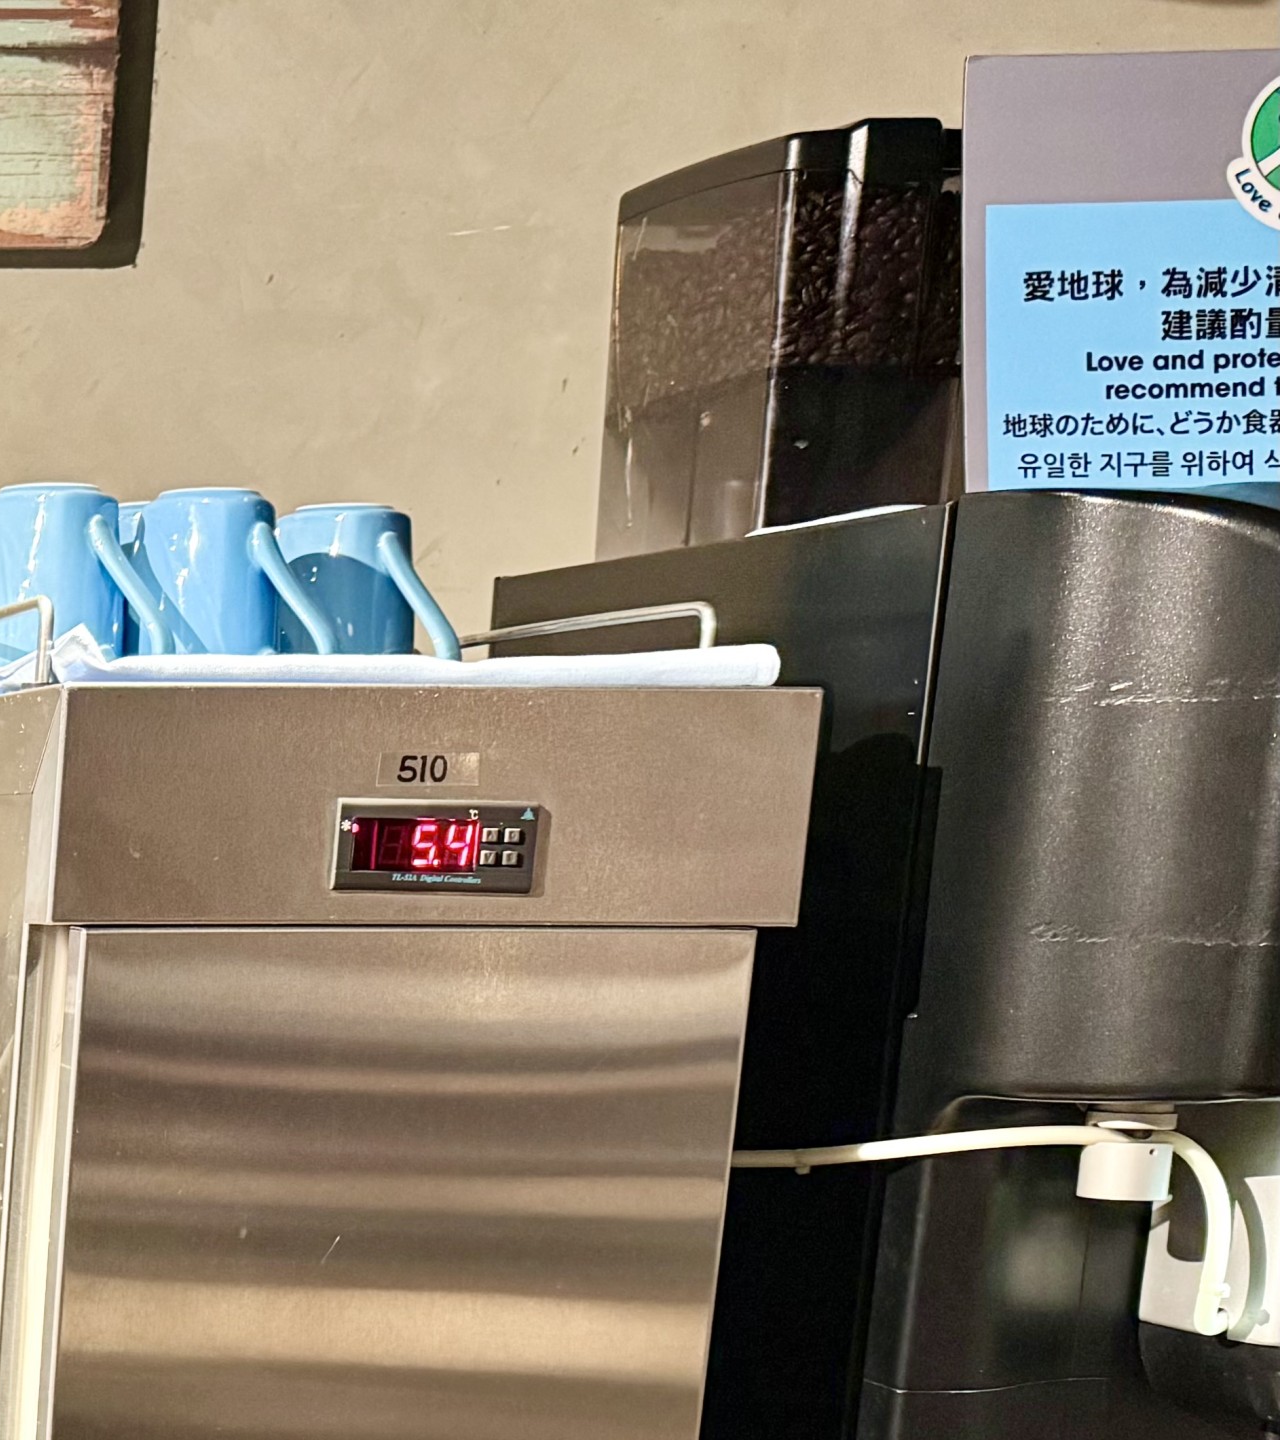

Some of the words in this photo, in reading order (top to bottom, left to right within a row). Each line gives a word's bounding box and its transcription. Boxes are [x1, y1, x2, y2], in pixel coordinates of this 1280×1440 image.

[1234, 167, 1273, 213] Love
[1086, 352, 1144, 372] Love
[1152, 350, 1204, 371] and
[1106, 377, 1266, 400] recommend
[1018, 452, 1092, 479] 유일한
[1099, 450, 1173, 478] 지구를
[1180, 449, 1255, 477] 위하여
[397, 755, 448, 783] 510
[411, 824, 474, 867] 5.4
